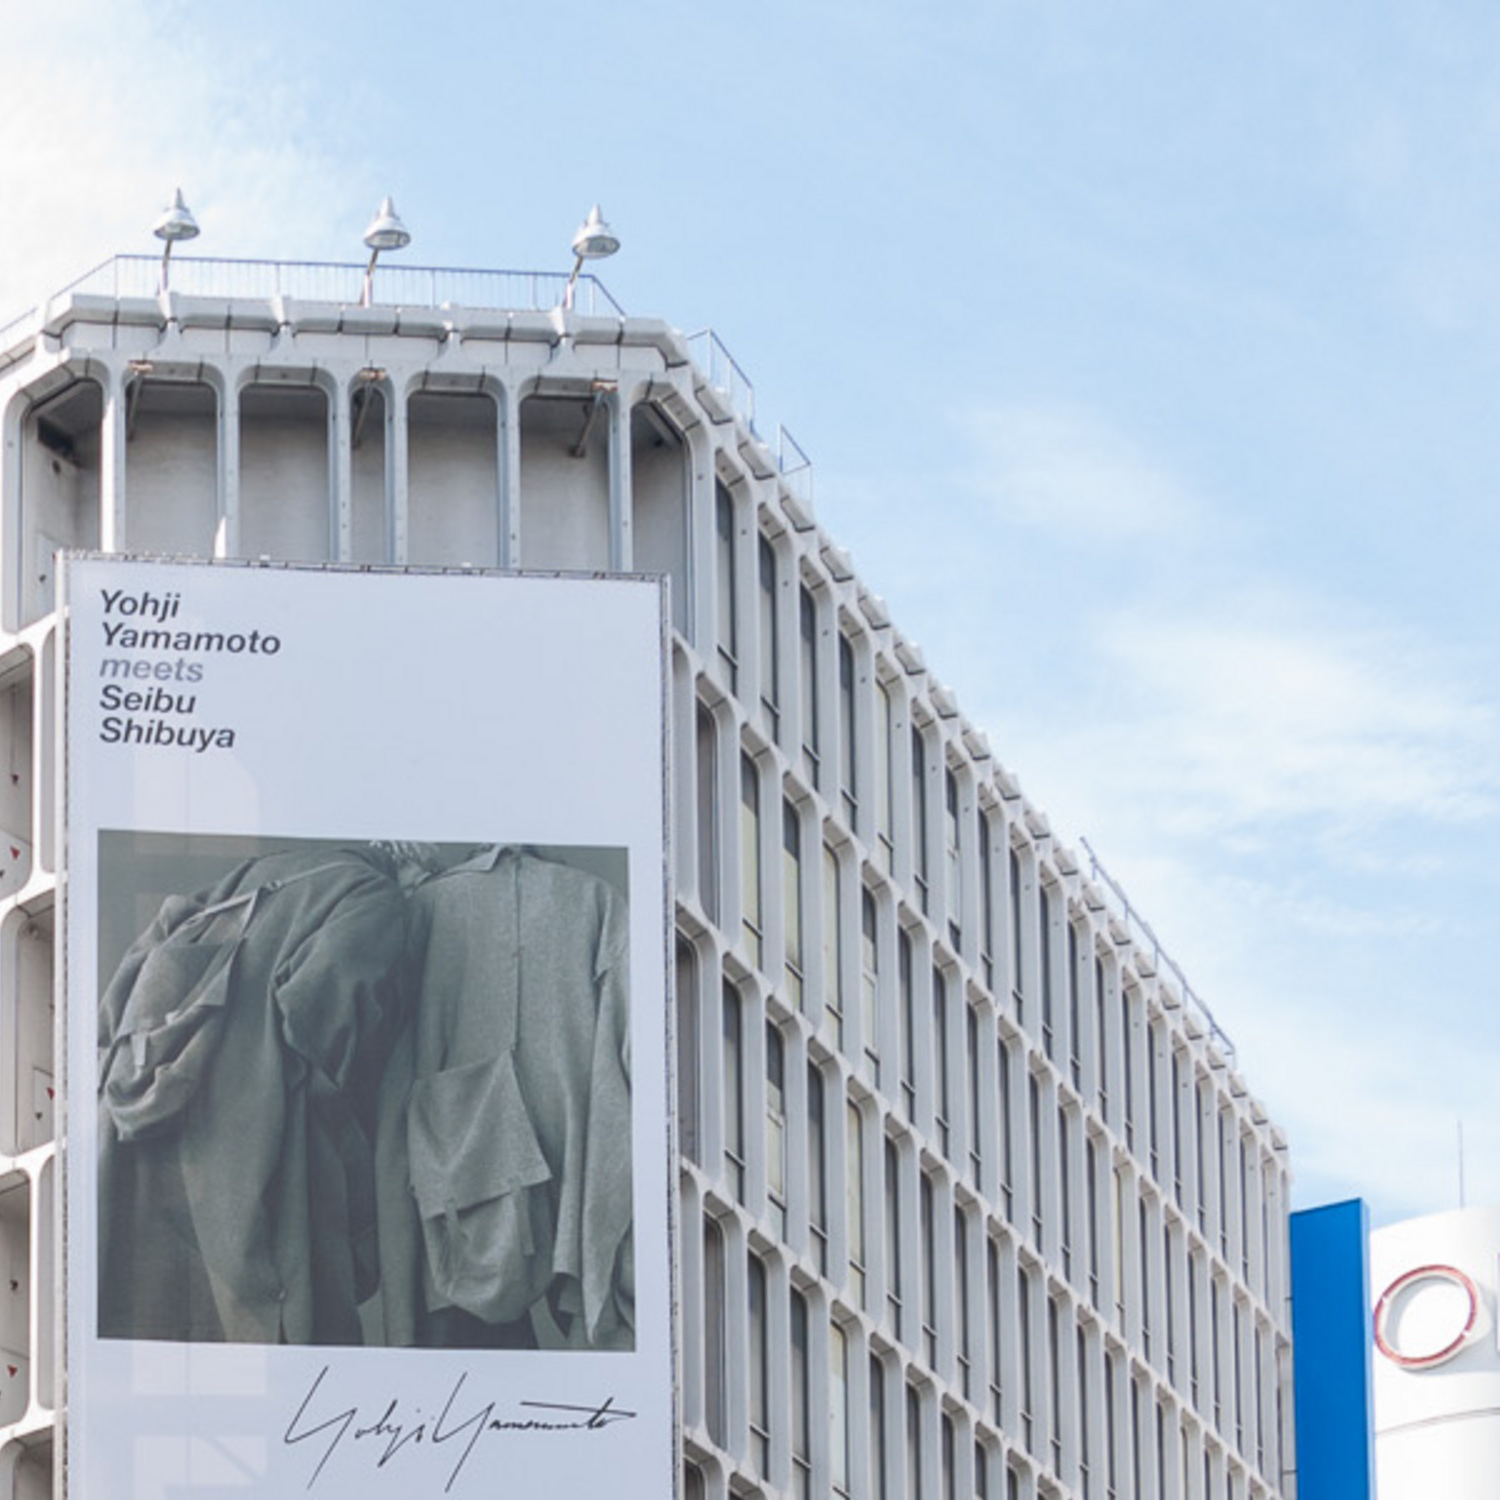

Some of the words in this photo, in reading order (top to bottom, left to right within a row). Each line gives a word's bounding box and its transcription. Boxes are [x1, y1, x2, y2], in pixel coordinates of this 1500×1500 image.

[100, 588, 181, 623] Yohji
[101, 621, 281, 656] Yamamoto
[99, 655, 204, 683] meets
[99, 684, 196, 714] Seibu
[99, 716, 236, 753] Shibuya
